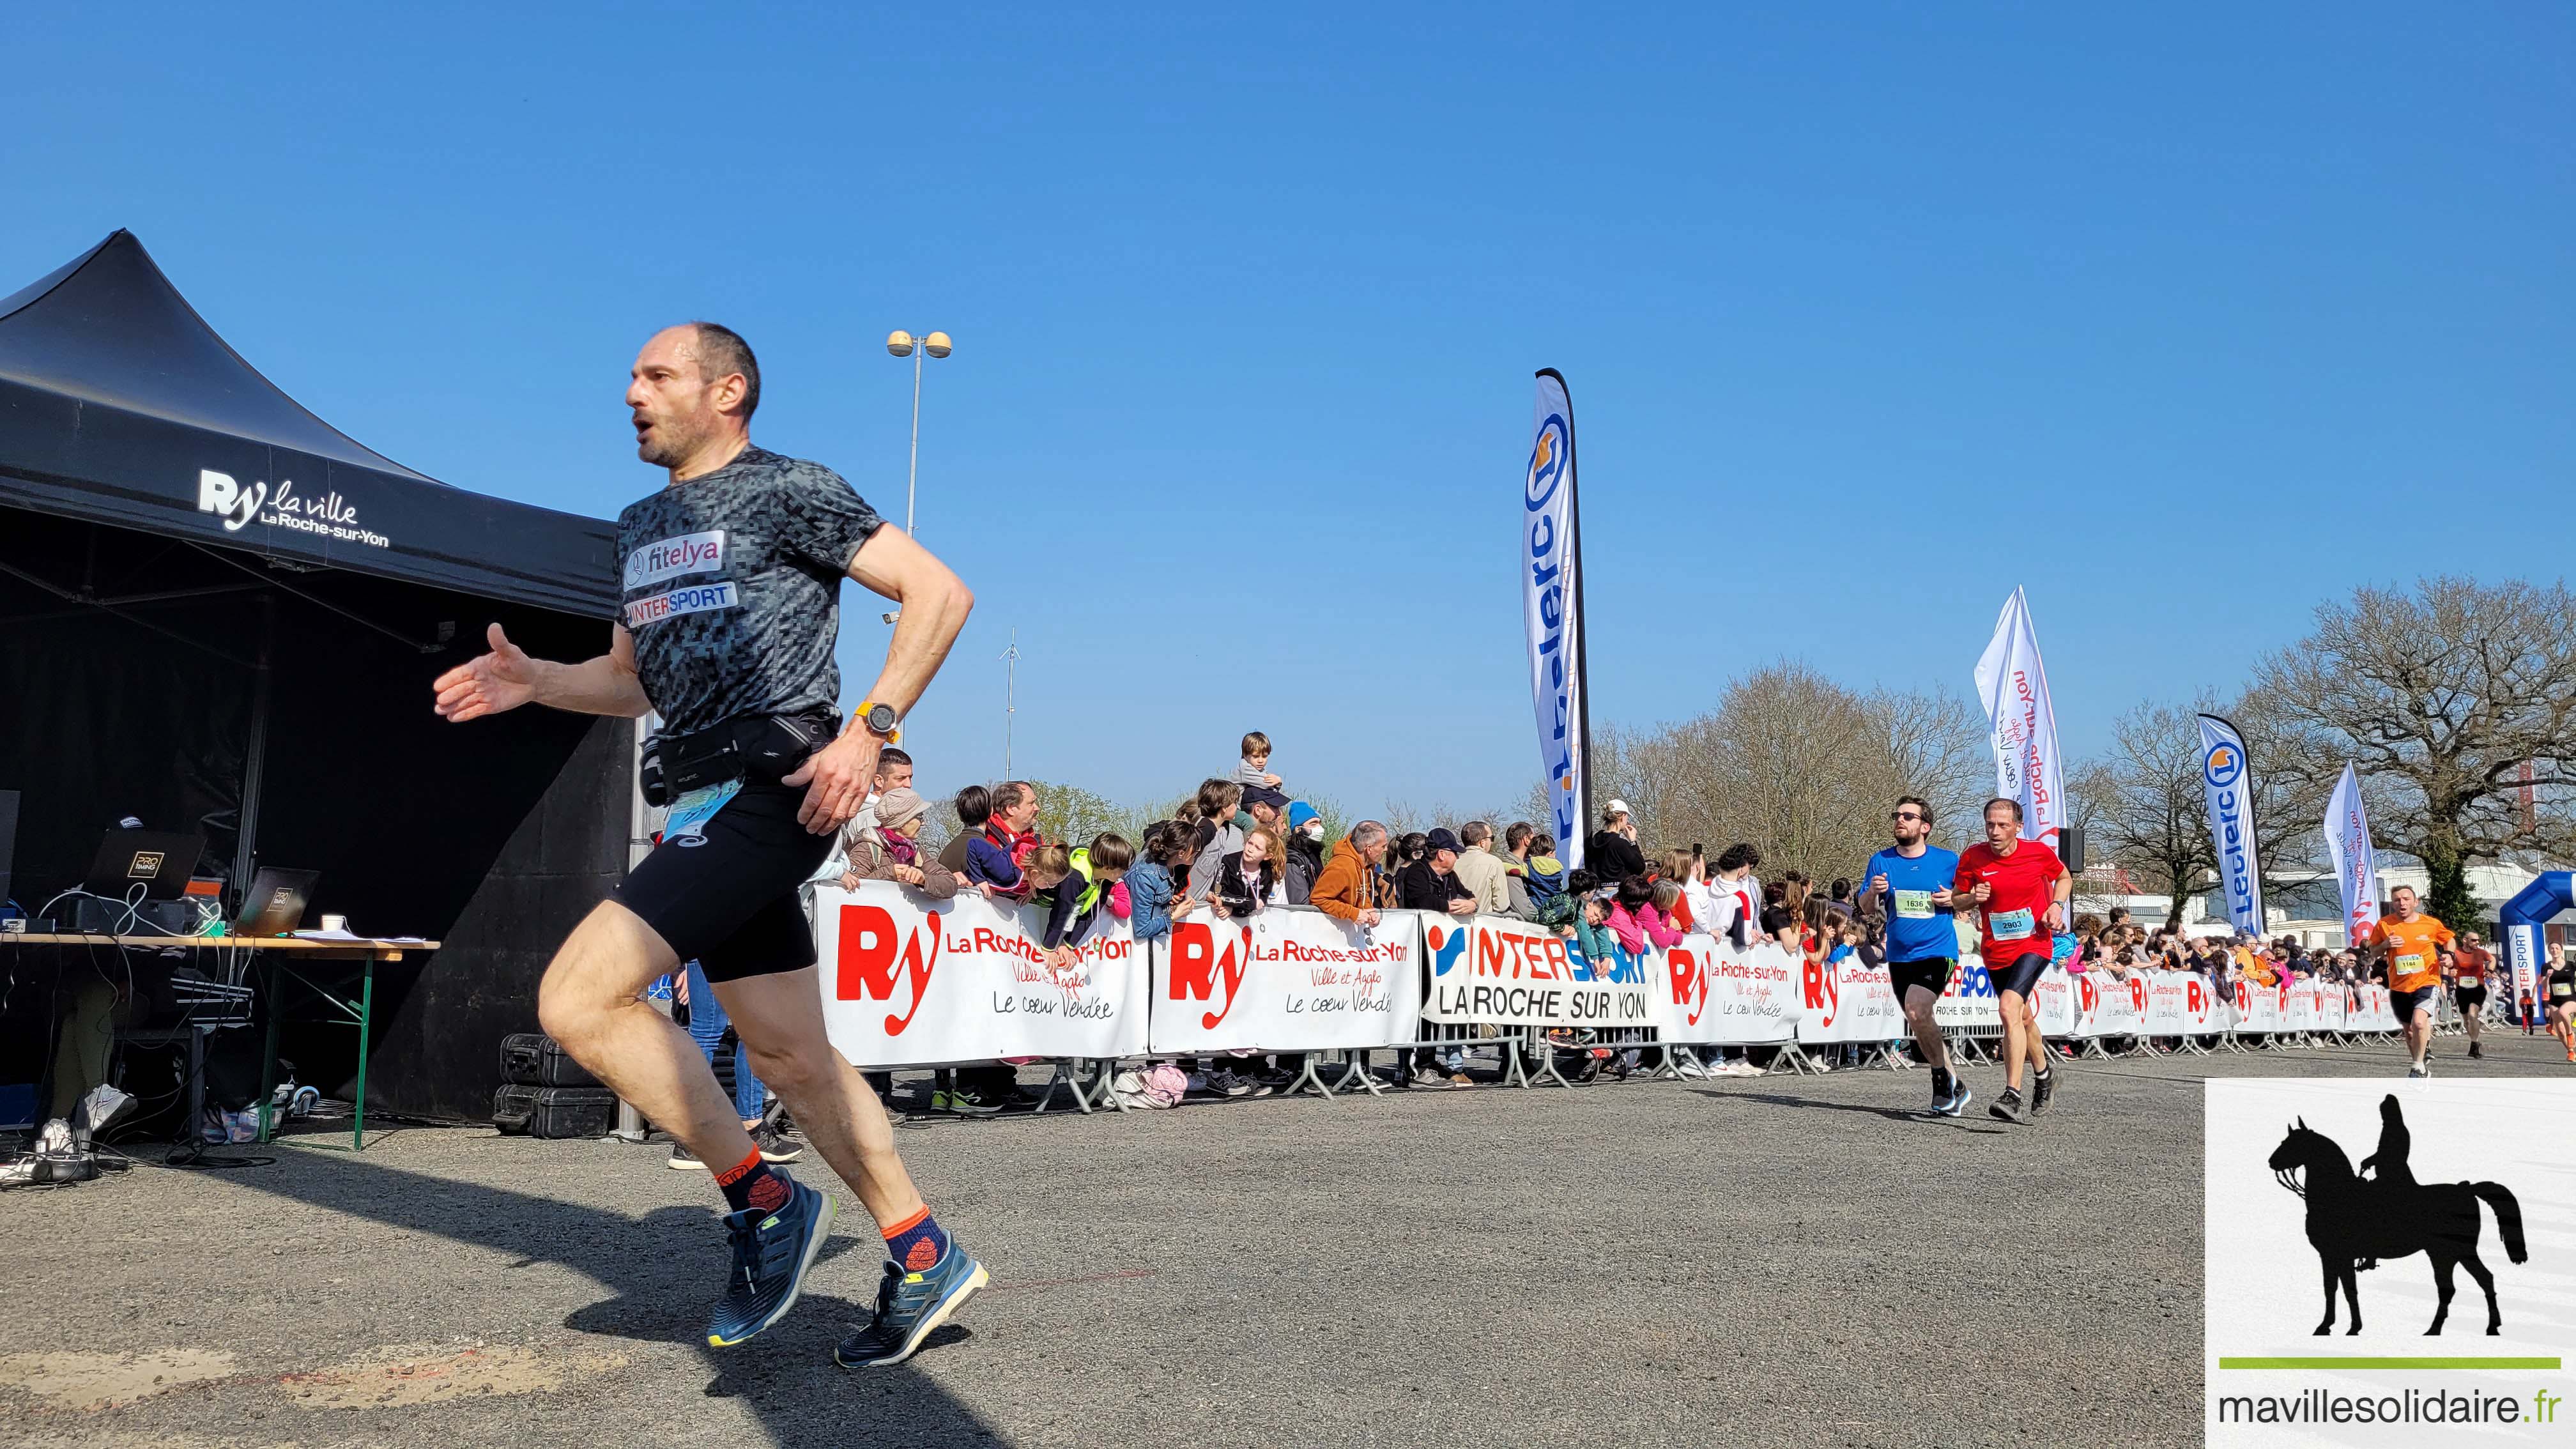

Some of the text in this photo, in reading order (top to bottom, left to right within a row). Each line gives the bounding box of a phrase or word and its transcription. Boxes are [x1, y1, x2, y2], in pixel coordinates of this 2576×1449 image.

[268, 480, 358, 525] la ville
[261, 512, 389, 548] La Roche-sur-Yon
[648, 540, 719, 572] fitelya
[630, 585, 728, 622] INTERSPORT
[137, 857, 158, 865] PRO
[2002, 920, 2023, 929] 2903
[947, 933, 972, 954] La
[1256, 940, 1407, 962] La Roche-sur-Yon
[1311, 965, 1382, 997] Ville et Agglo
[1721, 960, 1788, 982] Roche-sur-Yon
[1839, 972, 1852, 983] La
[994, 991, 1016, 1013] Le
[1059, 990, 1114, 1020] Vendée
[1286, 994, 1304, 1013] Le
[1439, 986, 1646, 1019] LA ROCHE SUR YON
[1723, 1000, 1733, 1015] Le
[1961, 1006, 1973, 1015] SUR
